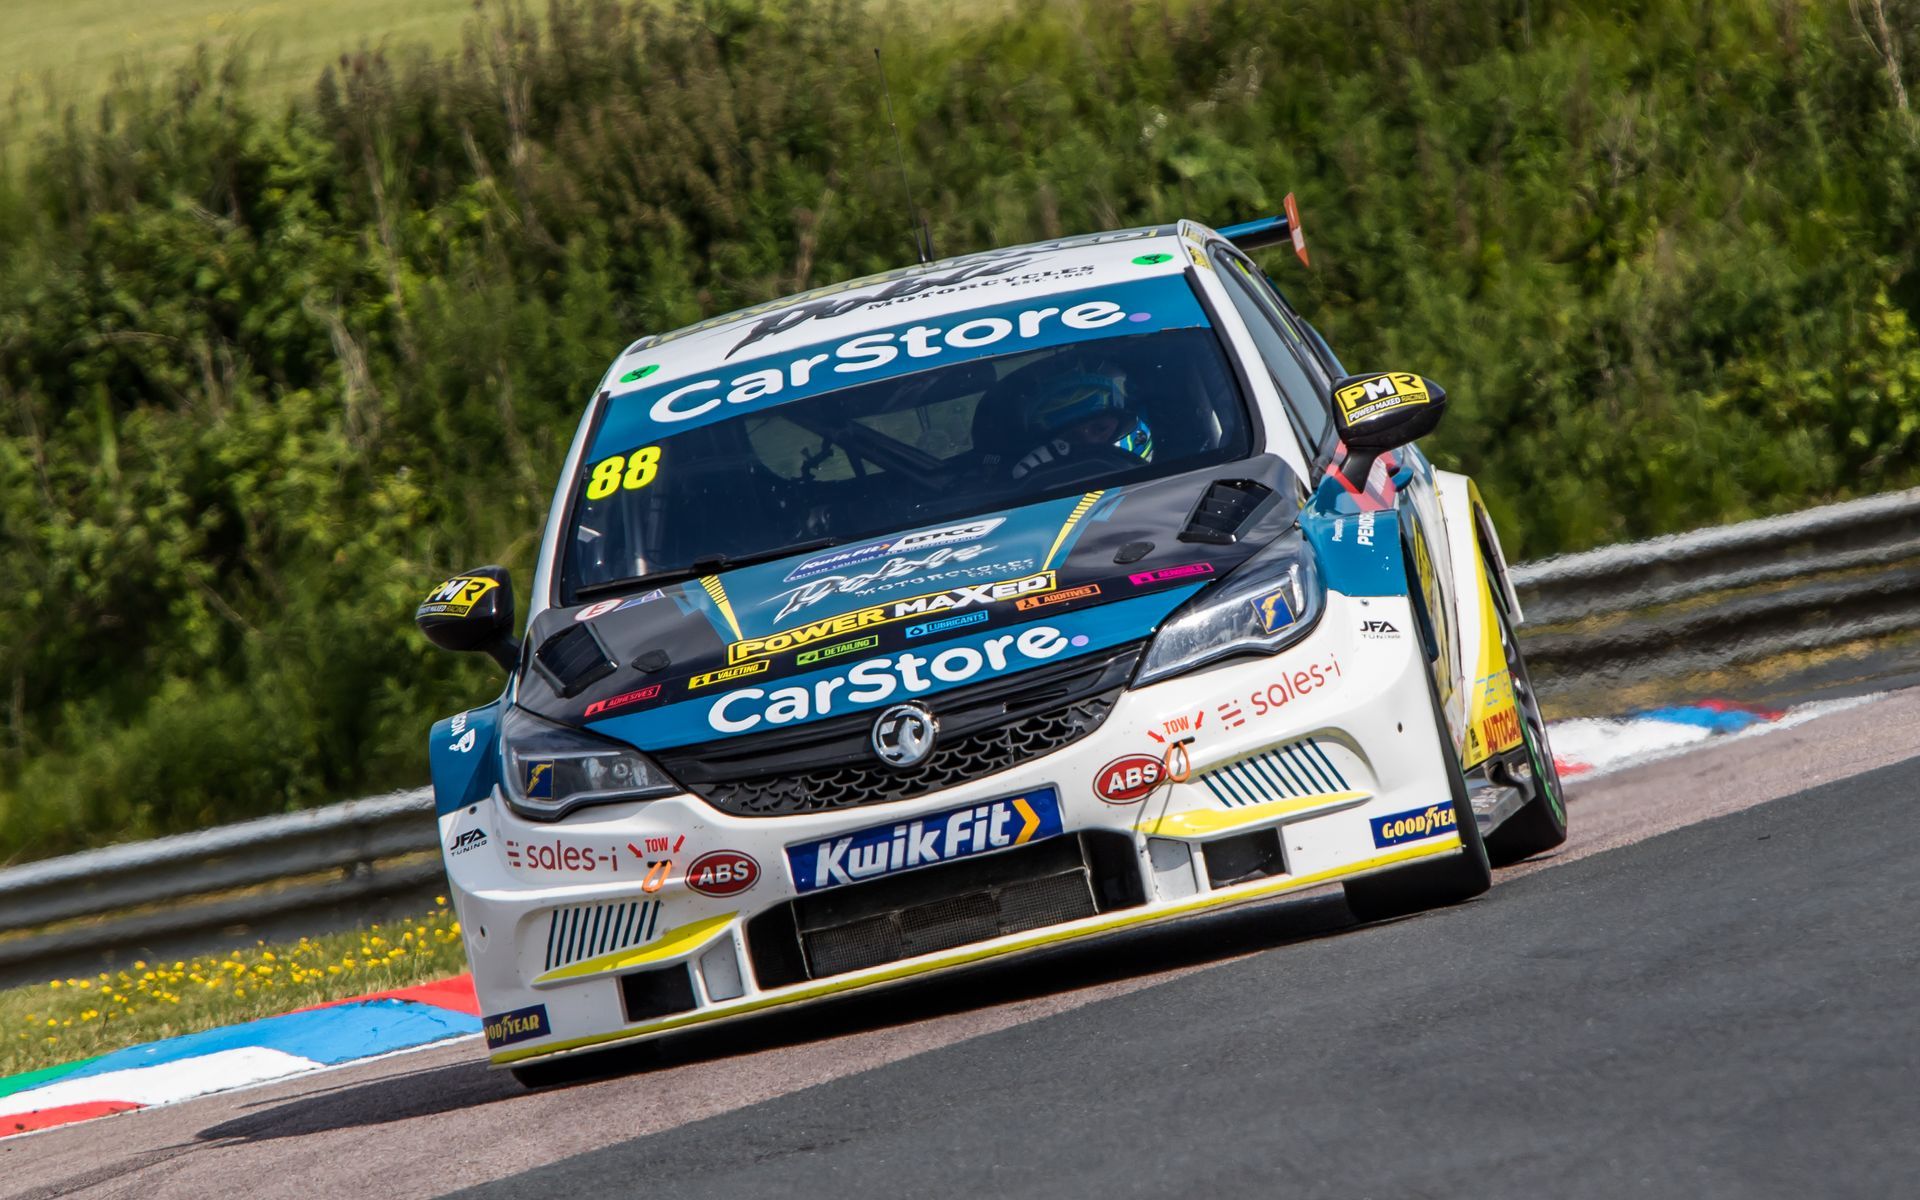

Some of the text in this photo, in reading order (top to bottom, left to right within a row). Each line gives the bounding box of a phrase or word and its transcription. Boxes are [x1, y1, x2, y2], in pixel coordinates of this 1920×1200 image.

[867, 264, 1095, 311] MOTORCYCLES
[1341, 374, 1420, 410] PMR
[586, 446, 661, 500] 88
[1043, 586, 1091, 603] ADDITIVES
[737, 574, 1047, 657] POWER MAXED
[929, 612, 985, 631] LUBRICANTS
[1359, 620, 1400, 633] JFA
[824, 639, 870, 656] DETAILING
[717, 663, 758, 680] VALETING
[1251, 653, 1341, 716] sales-i
[1163, 716, 1189, 736] TOW
[1107, 763, 1159, 795] ABS
[1382, 806, 1457, 839] GOODYEA
[450, 828, 487, 851] JFA
[451, 839, 487, 857] TUNING
[645, 837, 668, 853] TOW
[527, 840, 618, 872] sales-i
[698, 863, 750, 886] ABS
[484, 1014, 539, 1042] OODYEAR
